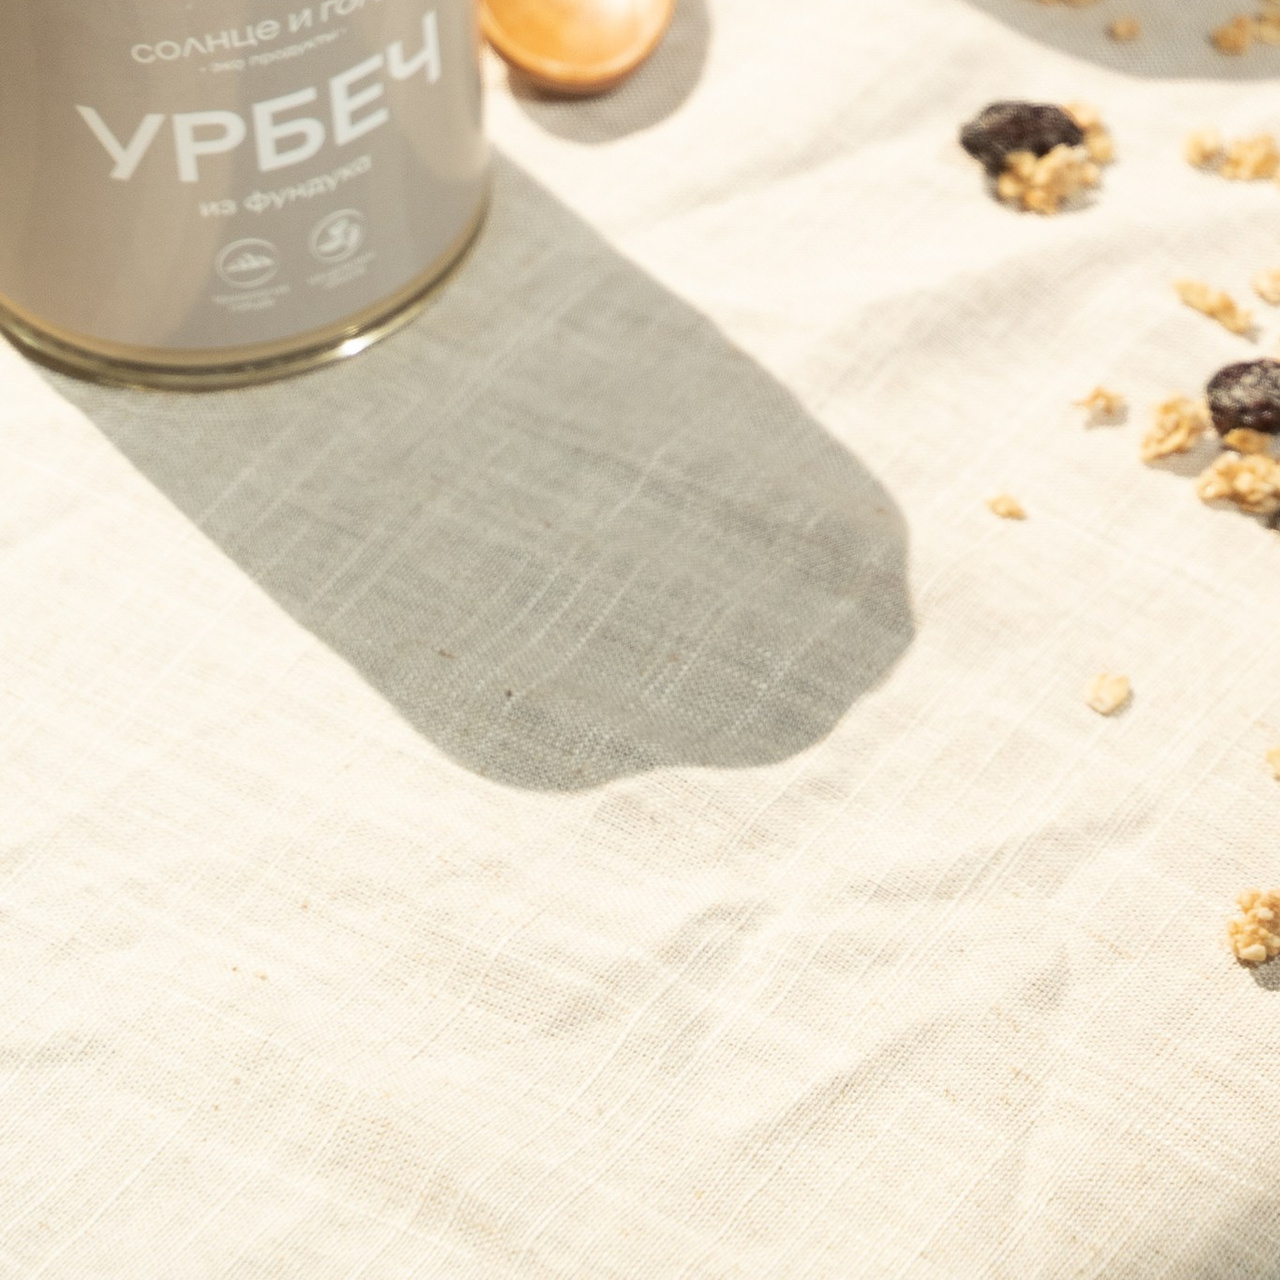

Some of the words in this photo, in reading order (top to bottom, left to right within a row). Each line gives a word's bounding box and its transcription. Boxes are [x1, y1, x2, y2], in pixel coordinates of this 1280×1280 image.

[288, 7, 312, 33] И
[75, 7, 442, 183] УРБЕЧ
[243, 154, 372, 214] фундука
